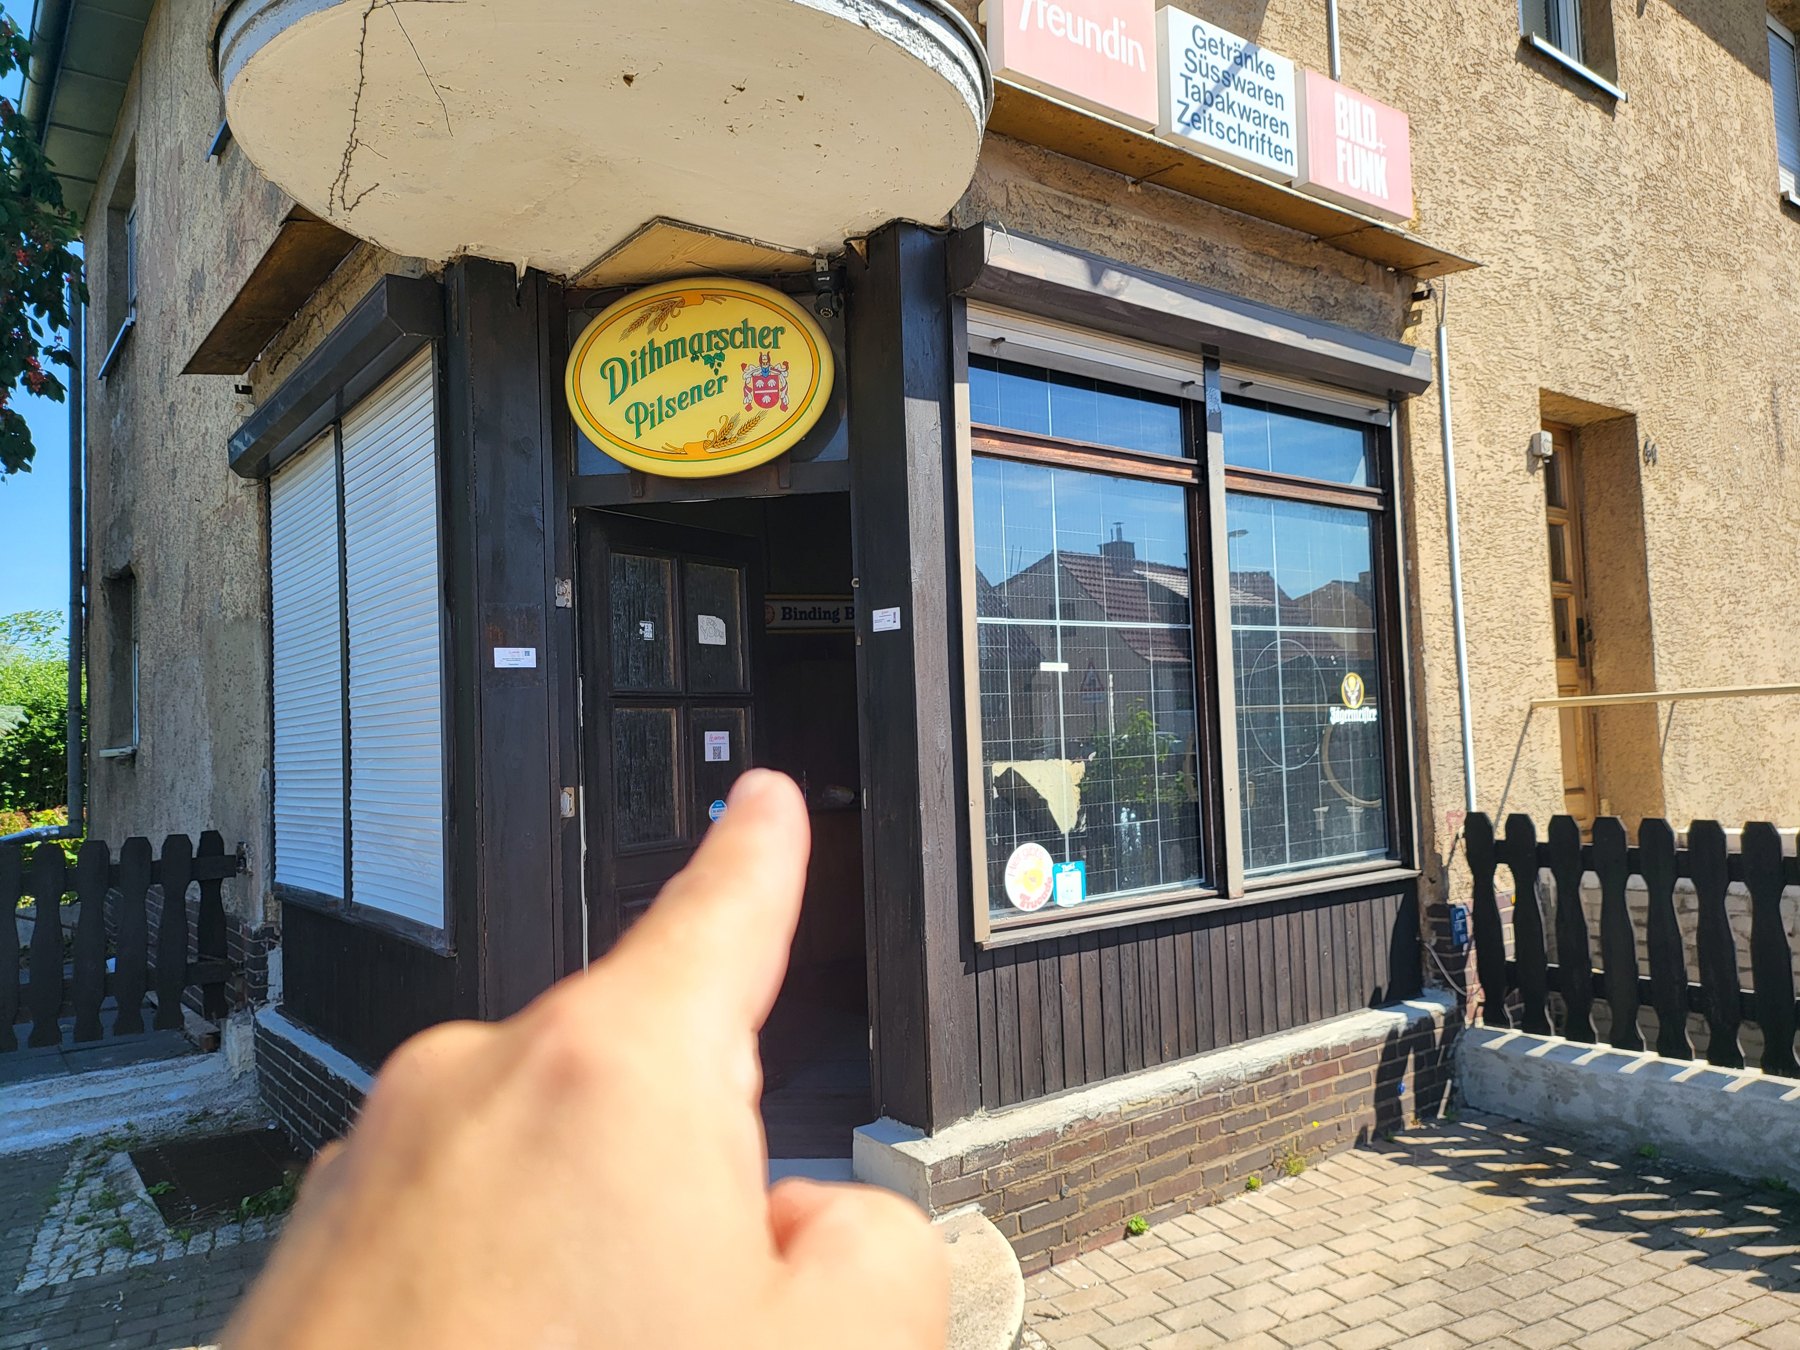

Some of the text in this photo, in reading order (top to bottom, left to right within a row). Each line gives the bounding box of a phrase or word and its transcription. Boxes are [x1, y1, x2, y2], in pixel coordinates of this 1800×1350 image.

[1184, 48, 1285, 111] Süsswaren
[1191, 24, 1276, 81] Getränke
[1176, 100, 1294, 166] Zeitschriften
[1179, 73, 1290, 139] Tabakwaren
[1335, 137, 1389, 200] FUNK
[599, 317, 786, 405] Dithmarscher
[624, 374, 728, 439] Pilsener
[780, 606, 840, 623] Binding
